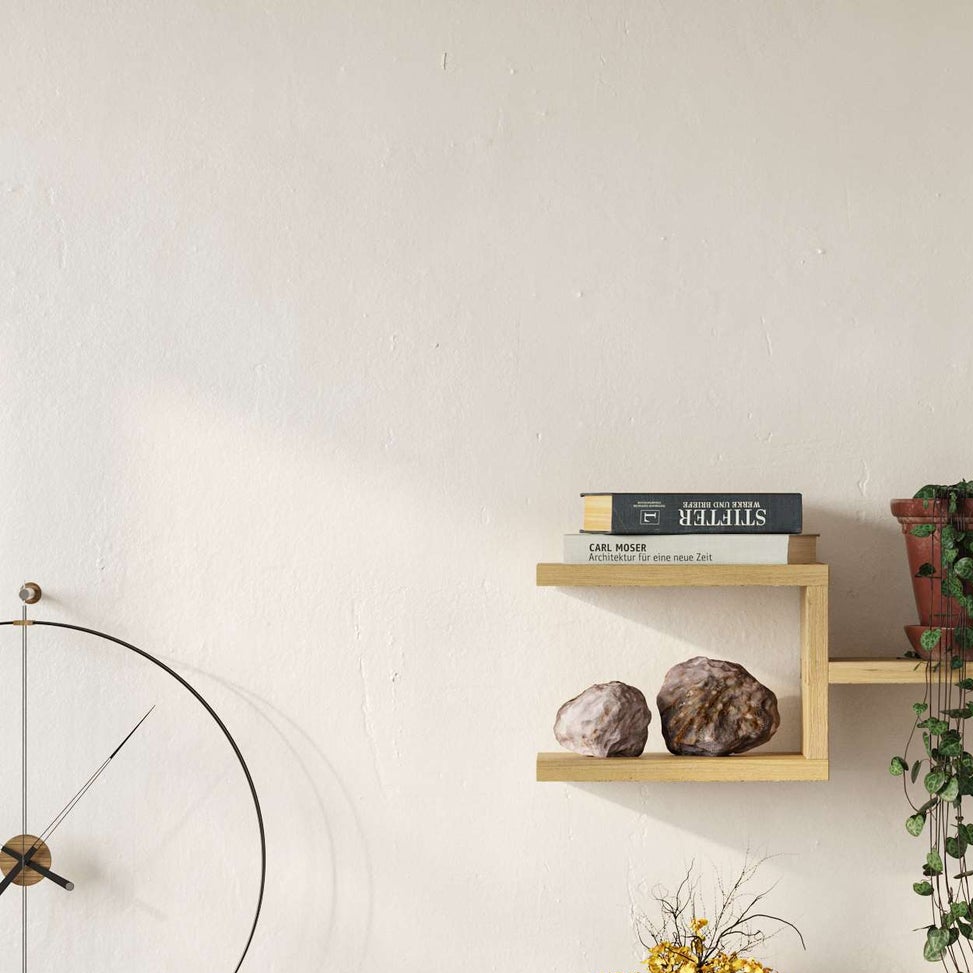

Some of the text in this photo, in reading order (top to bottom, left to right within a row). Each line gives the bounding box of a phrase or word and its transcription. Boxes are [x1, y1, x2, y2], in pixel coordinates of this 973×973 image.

[678, 508, 767, 526] STIFTER
[589, 543, 647, 552] CARL MOSER
[588, 552, 713, 562] Architektur für eine neue Zeit
